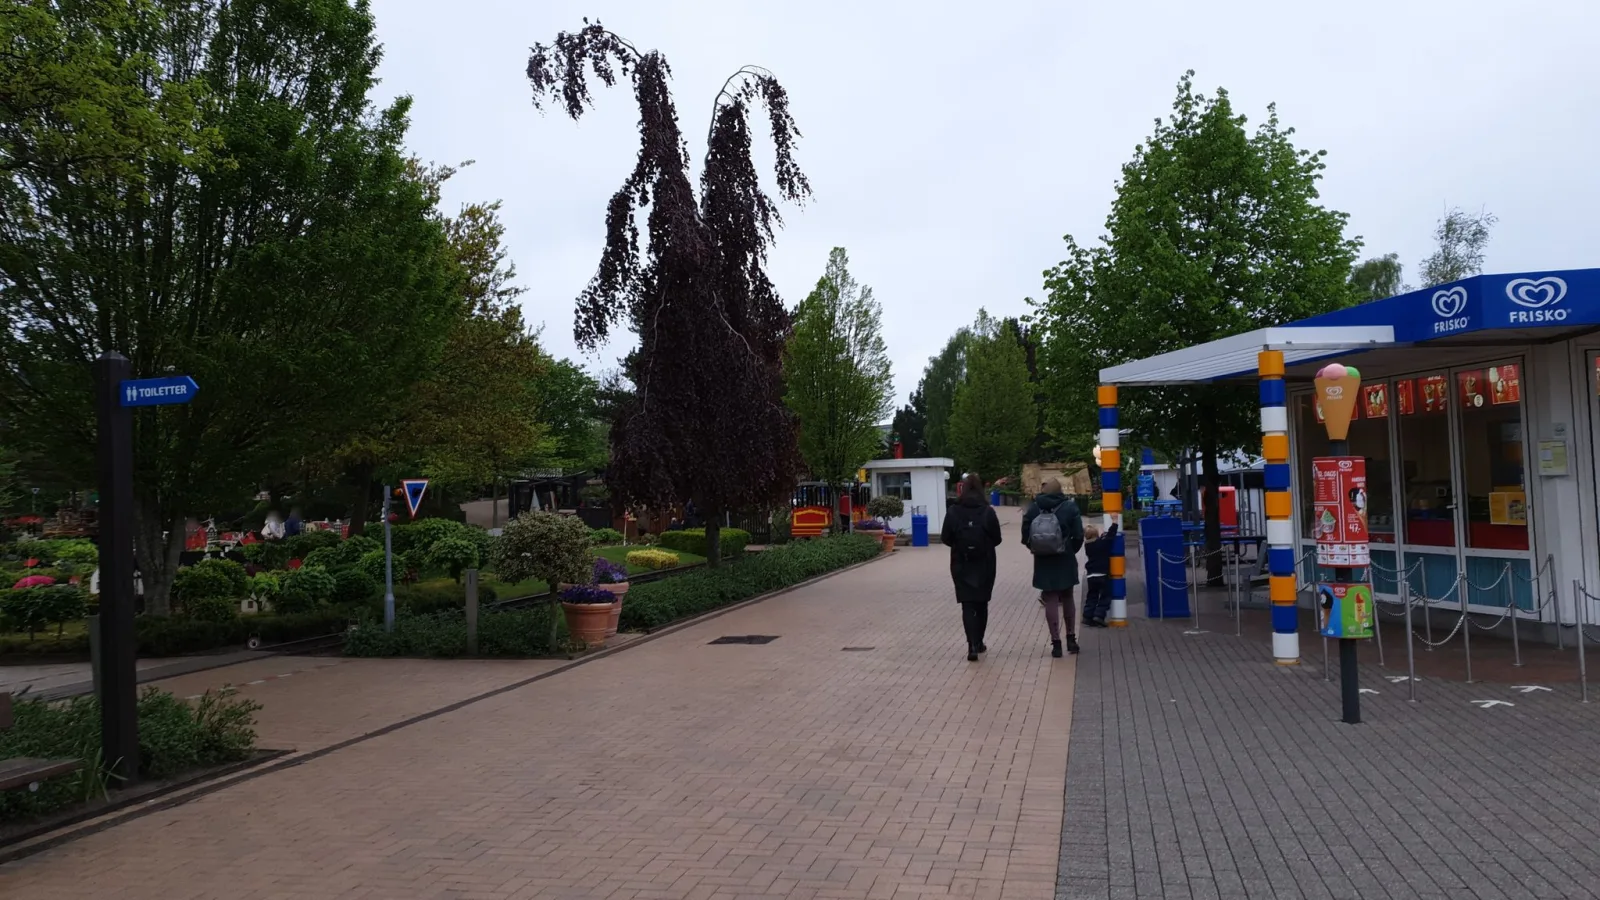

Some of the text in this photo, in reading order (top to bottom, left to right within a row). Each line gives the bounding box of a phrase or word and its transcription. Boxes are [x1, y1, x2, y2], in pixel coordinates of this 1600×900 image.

[1509, 309, 1567, 323] FRISKO
[1434, 316, 1468, 333] FRISKO
[138, 384, 187, 398] TOILETTER
